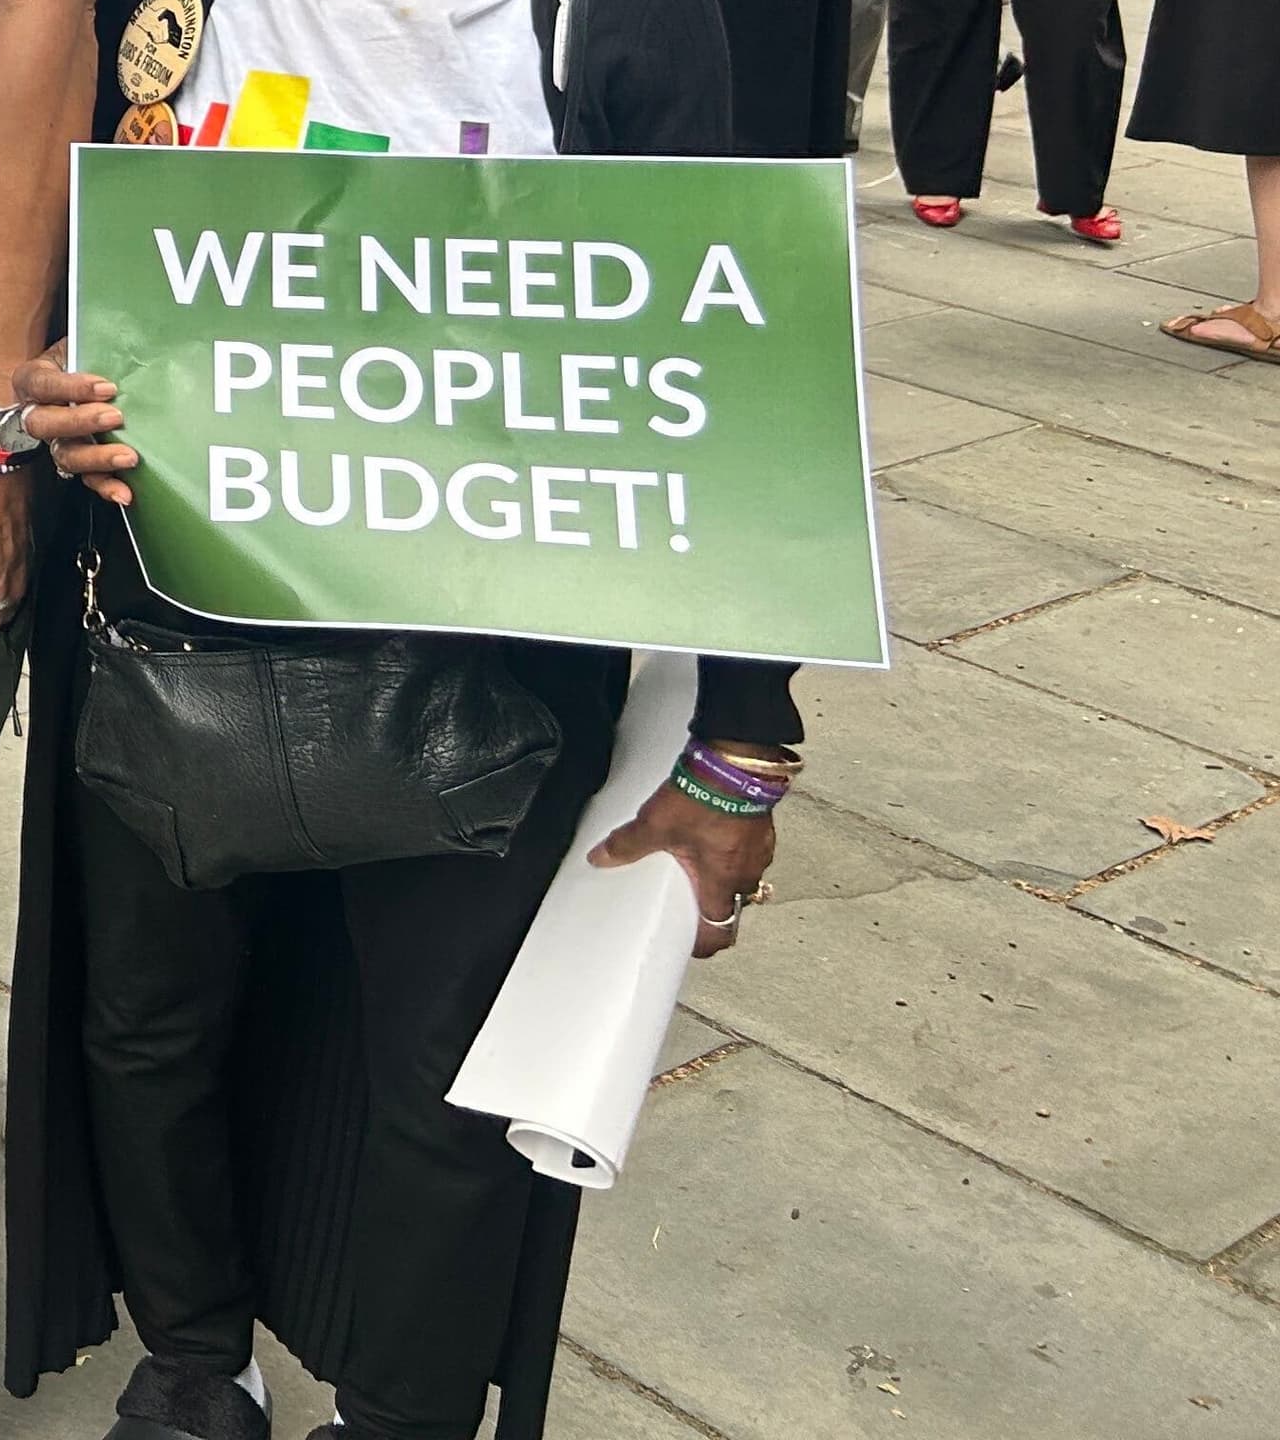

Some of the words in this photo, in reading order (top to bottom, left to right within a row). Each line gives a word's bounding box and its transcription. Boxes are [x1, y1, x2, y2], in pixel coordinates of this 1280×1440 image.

[140, 54, 174, 88] FREEDOM
[153, 228, 326, 312] WE
[359, 234, 652, 321] NEED
[680, 243, 767, 326] A
[213, 339, 709, 439] PEOPLE'S
[207, 444, 693, 554] BUDGET!
